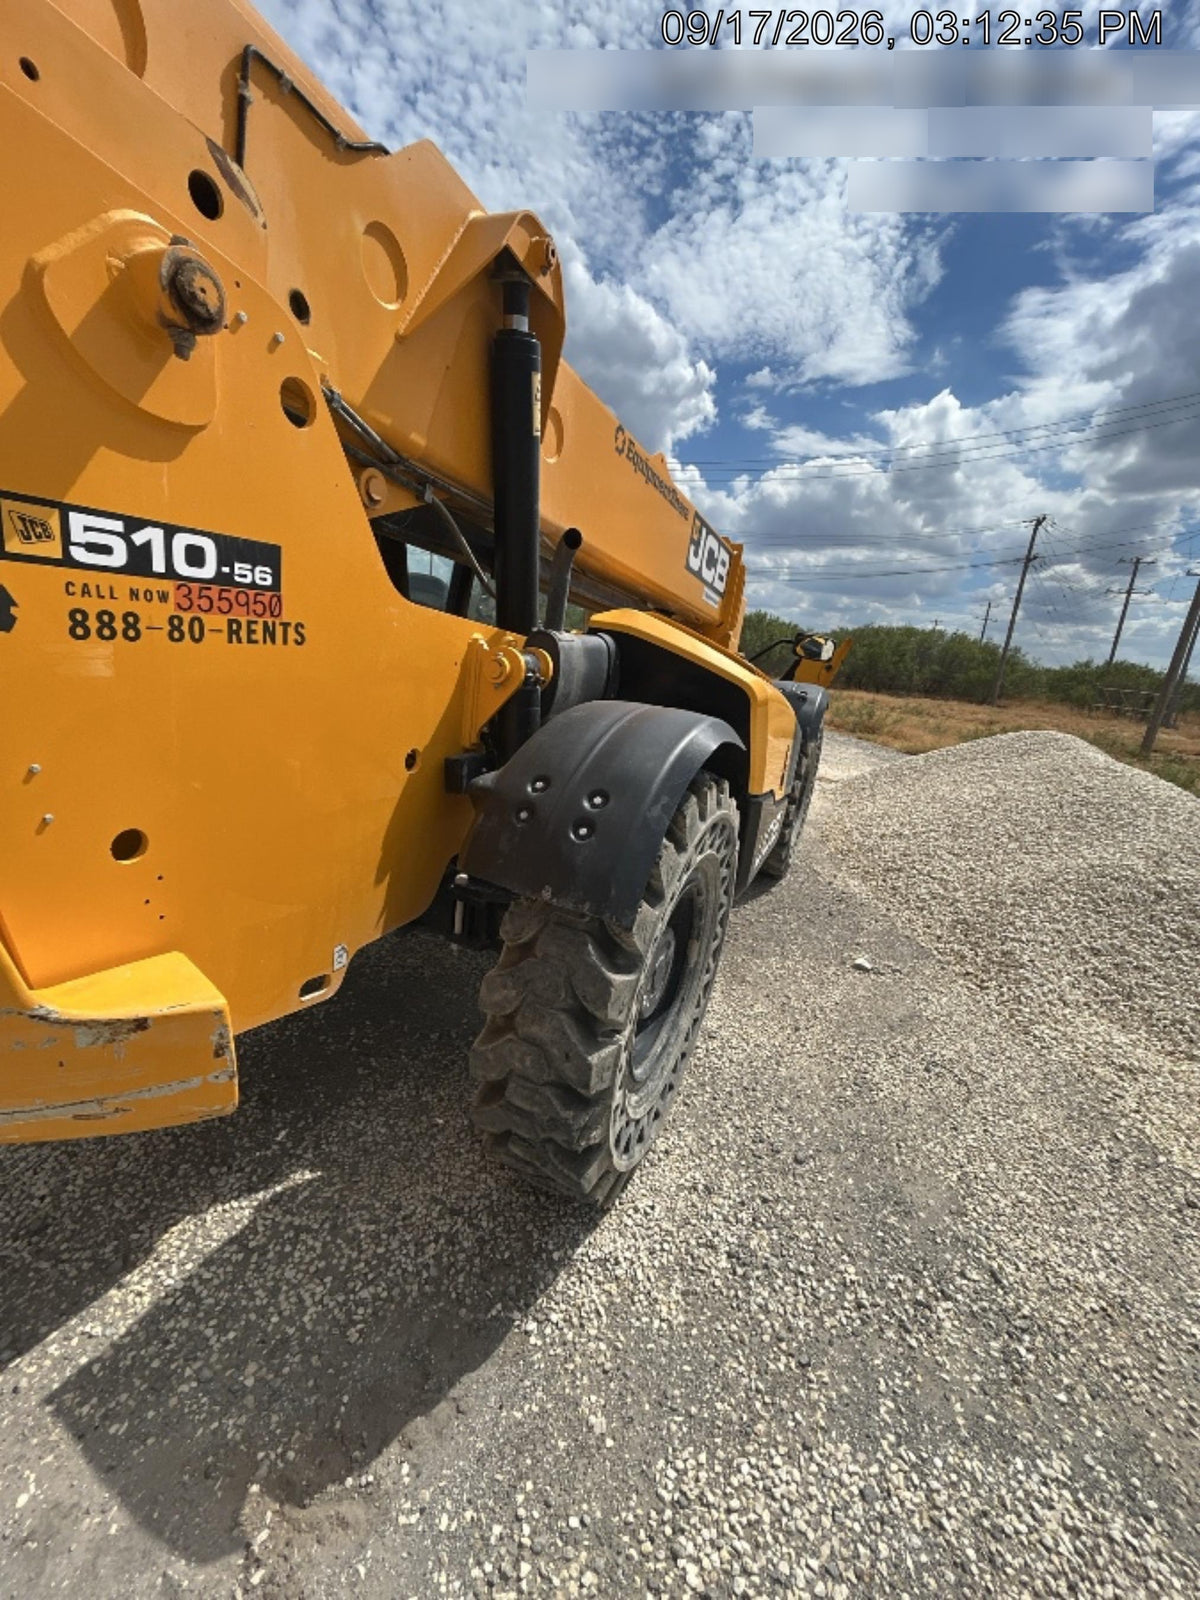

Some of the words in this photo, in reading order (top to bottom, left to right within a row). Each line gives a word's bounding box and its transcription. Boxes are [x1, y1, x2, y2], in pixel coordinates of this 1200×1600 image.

[15, 513, 54, 542] JCB
[687, 526, 731, 595] JCB
[65, 581, 118, 600] CALL
[129, 587, 170, 604] NOW
[175, 583, 283, 619] 355950
[68, 607, 306, 646] 888-80-RENTS
